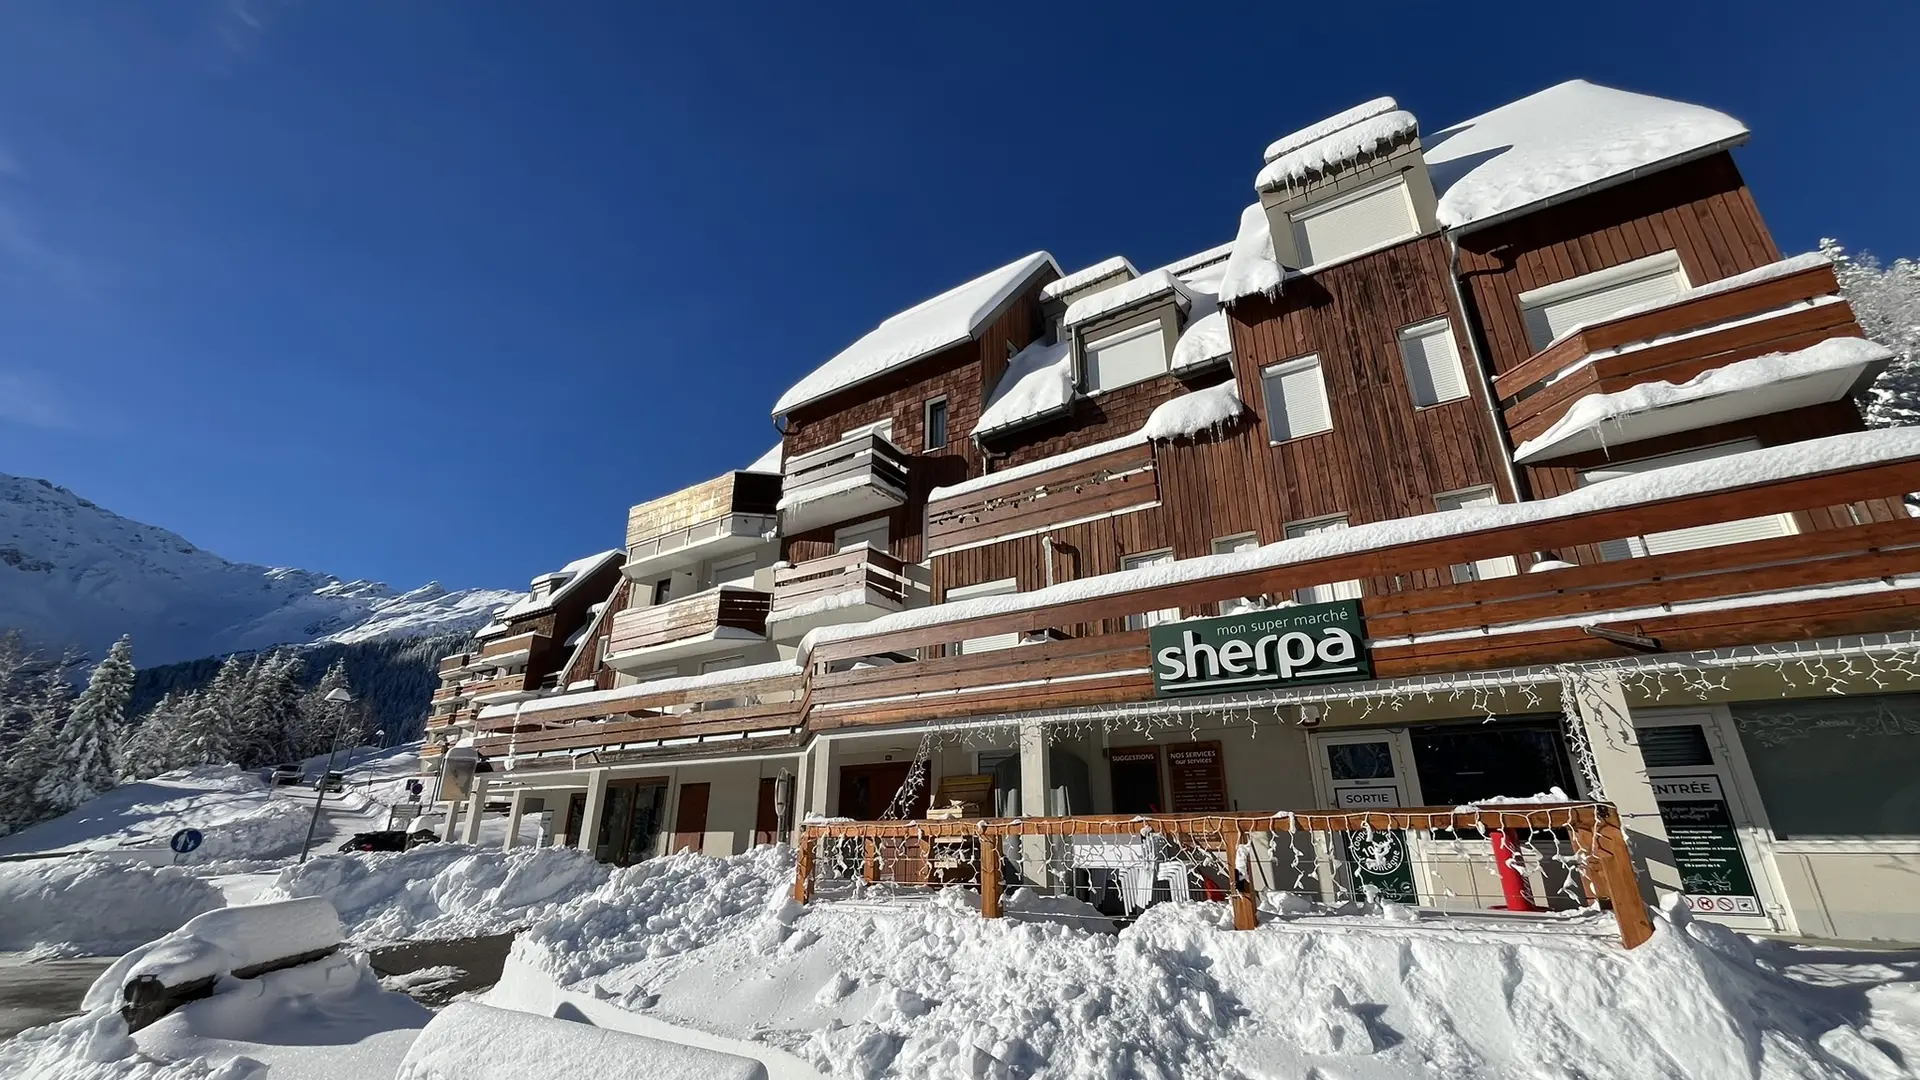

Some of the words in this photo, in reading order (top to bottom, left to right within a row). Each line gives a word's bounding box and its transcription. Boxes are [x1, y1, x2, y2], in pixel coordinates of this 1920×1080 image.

[1217, 625, 1247, 636] mon
[1251, 619, 1289, 633] super
[1294, 607, 1349, 627] marché
[1157, 627, 1356, 680] sherpa
[1111, 753, 1155, 762] SUGGESTIONS
[1185, 750, 1216, 758] SERVICES
[1345, 793, 1389, 804] SORTIE
[1366, 850, 1401, 871] ontagne
